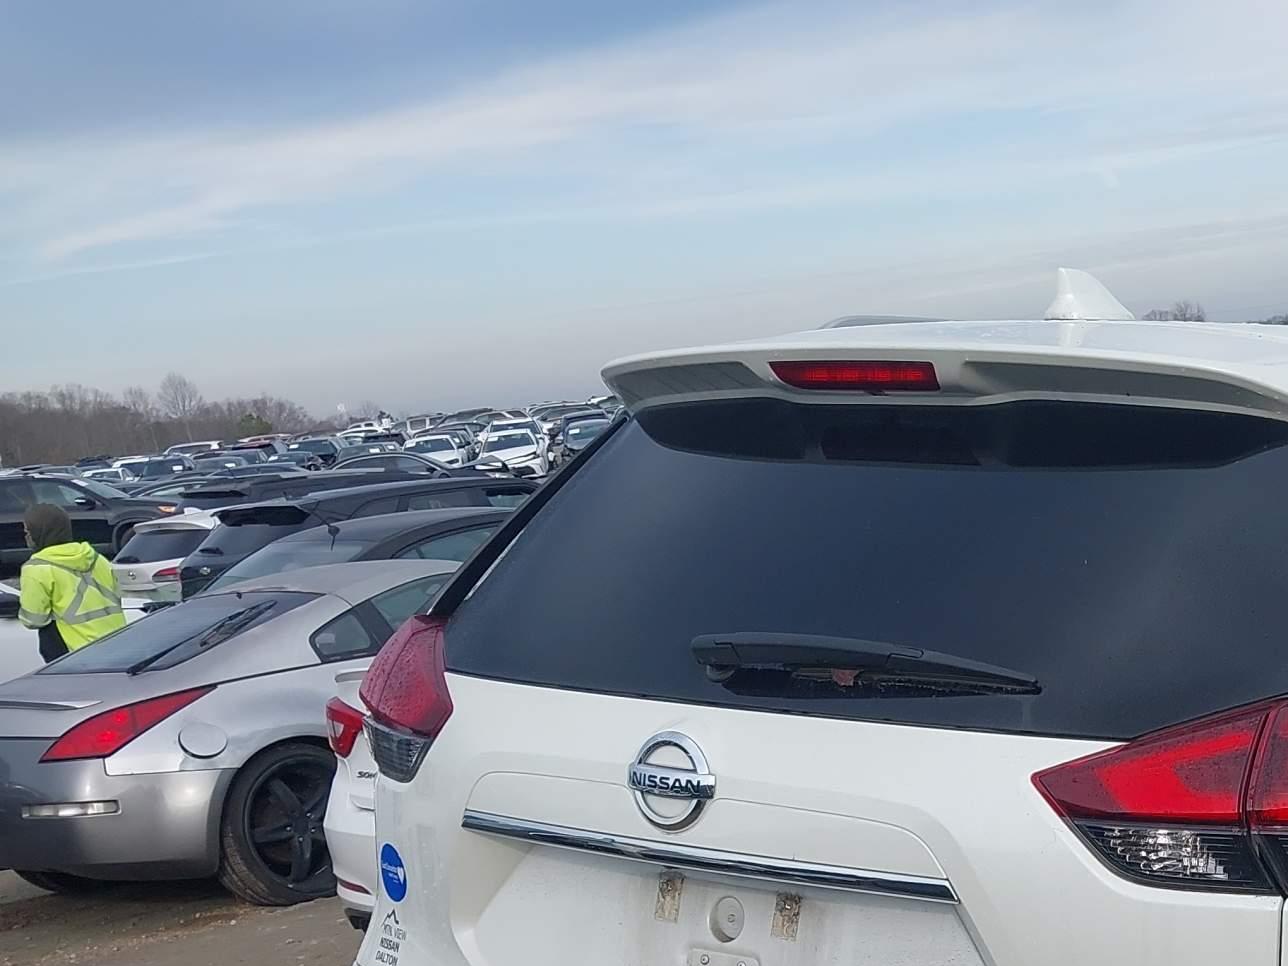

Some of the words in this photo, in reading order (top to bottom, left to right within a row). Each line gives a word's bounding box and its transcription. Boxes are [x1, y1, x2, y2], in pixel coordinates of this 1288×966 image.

[631, 770, 701, 795] NISSAN
[379, 936, 400, 953] NISSAN
[375, 950, 399, 966] DALTON
